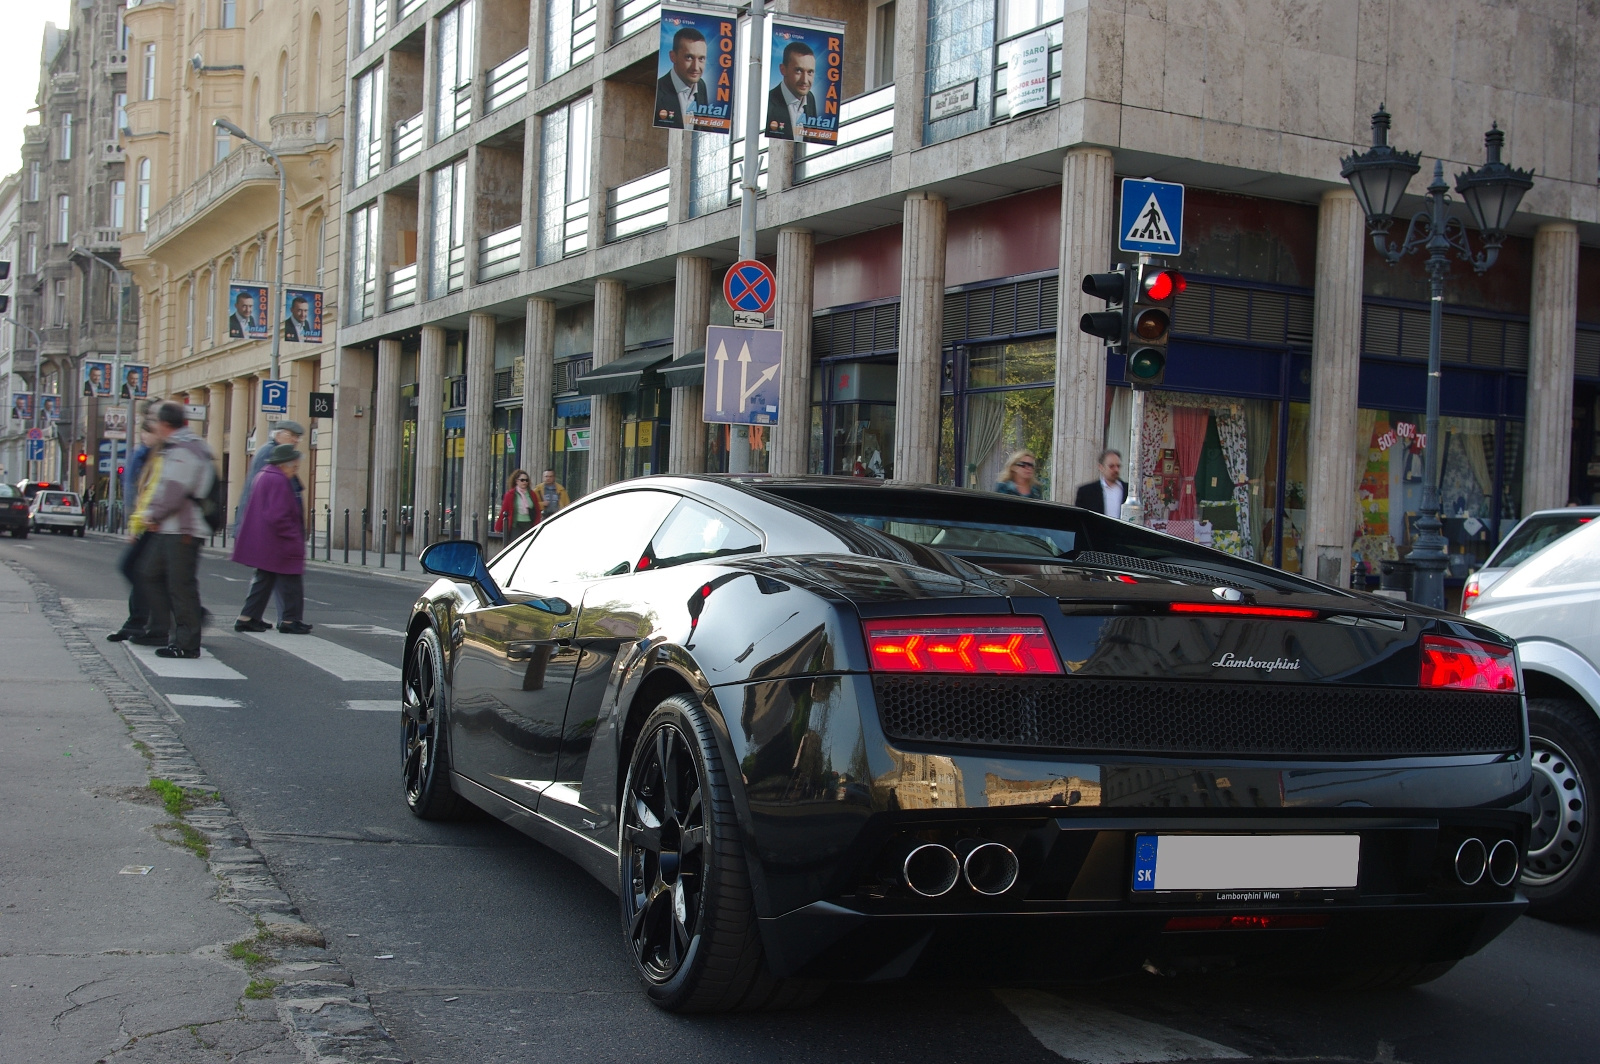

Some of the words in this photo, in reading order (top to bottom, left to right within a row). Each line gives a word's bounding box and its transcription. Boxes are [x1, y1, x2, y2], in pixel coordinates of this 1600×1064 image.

[1023, 46, 1045, 57] ISARO
[716, 22, 733, 102] ROGÁN
[825, 37, 840, 115] ROGÁN
[1030, 77, 1046, 86] SALE
[686, 101, 728, 116] Antal
[796, 113, 836, 129] Antal
[268, 388, 280, 404] P
[1378, 430, 1397, 451] 50%
[1398, 422, 1416, 438] 60%
[1416, 434, 1427, 448] 70
[1212, 652, 1300, 672] Lamborghini
[1137, 870, 1152, 882] SK
[1216, 892, 1262, 901] Lamborghini
[1263, 892, 1280, 900] Wien
